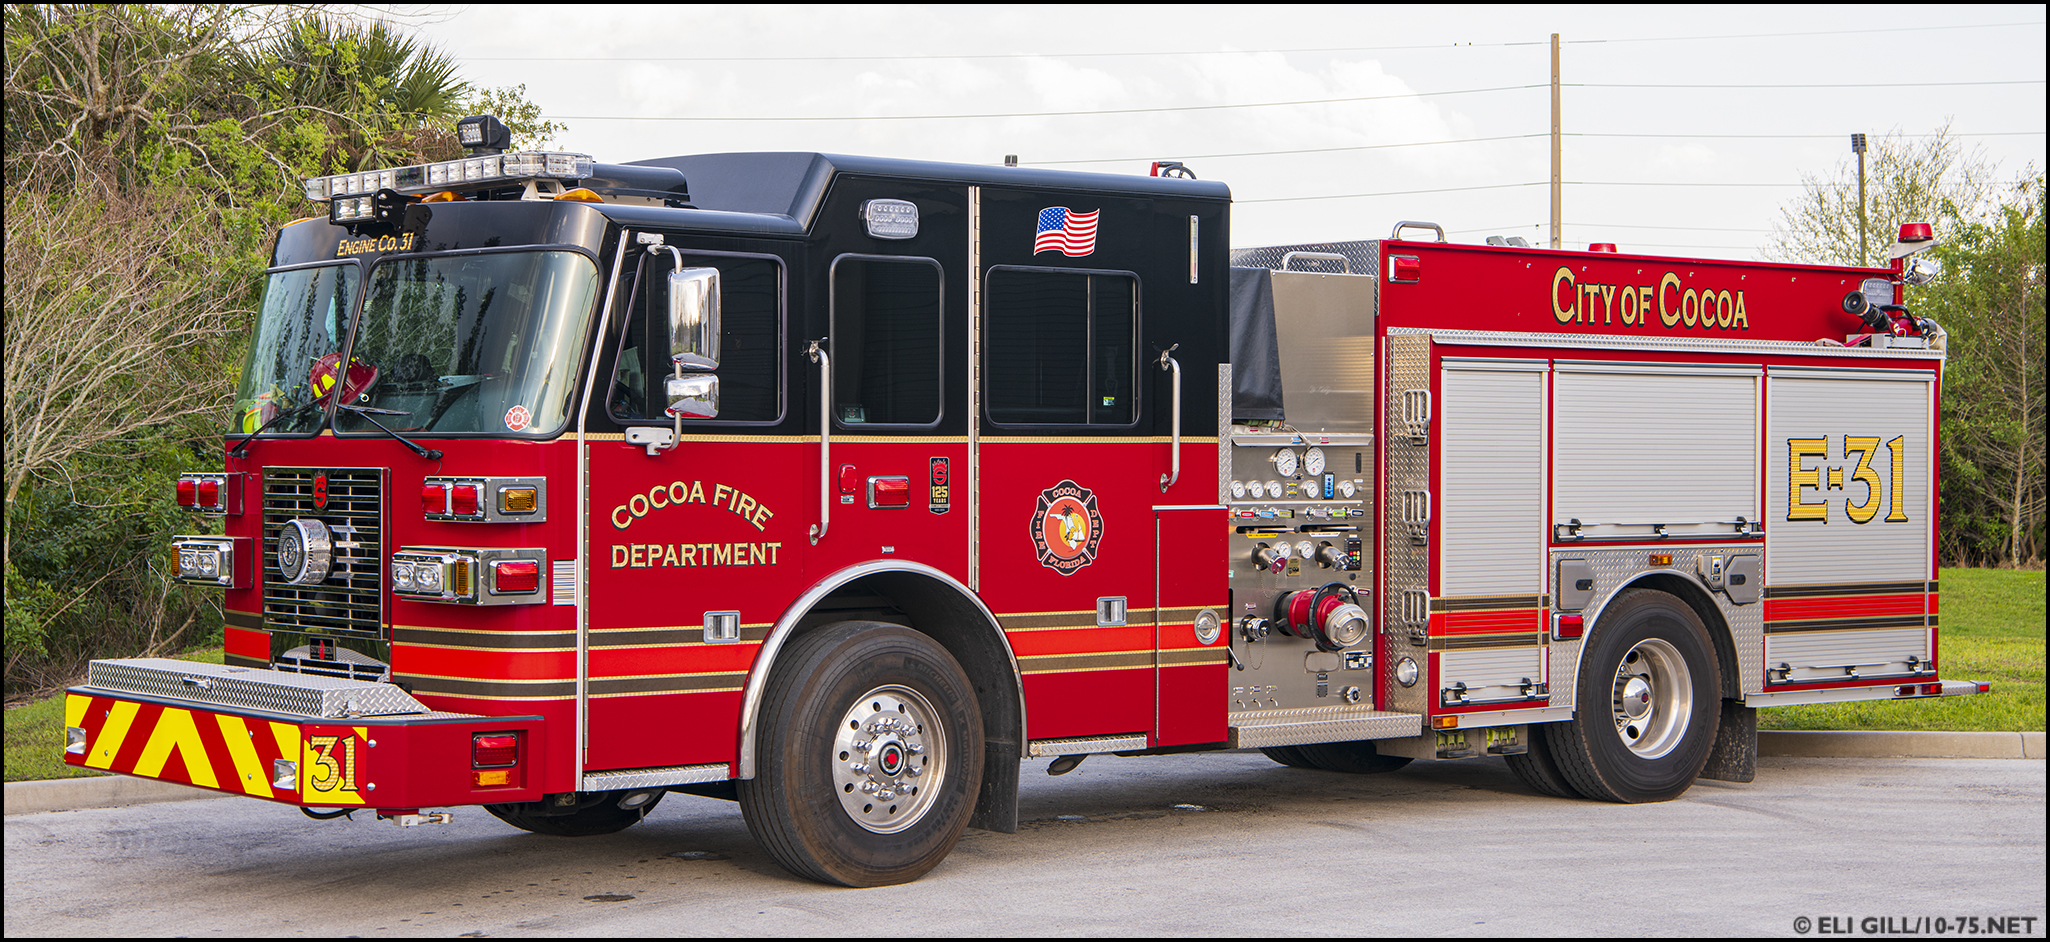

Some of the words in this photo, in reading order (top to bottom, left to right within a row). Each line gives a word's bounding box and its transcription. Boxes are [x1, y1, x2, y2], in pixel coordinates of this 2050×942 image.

[399, 232, 415, 251] 31
[1620, 284, 1653, 327] OF
[932, 485, 948, 498] 125
[1052, 487, 1082, 499] COCOA
[1786, 434, 1909, 525] E-31
[610, 480, 706, 531] COCOA
[711, 483, 775, 532] FIRE
[1035, 510, 1046, 550] FIRE
[1090, 509, 1100, 549] DEPT
[610, 542, 782, 570] DEPARTMENT
[1048, 555, 1087, 569] FLORIDA
[918, 664, 959, 702] MICHELIN
[310, 734, 360, 793] 31
